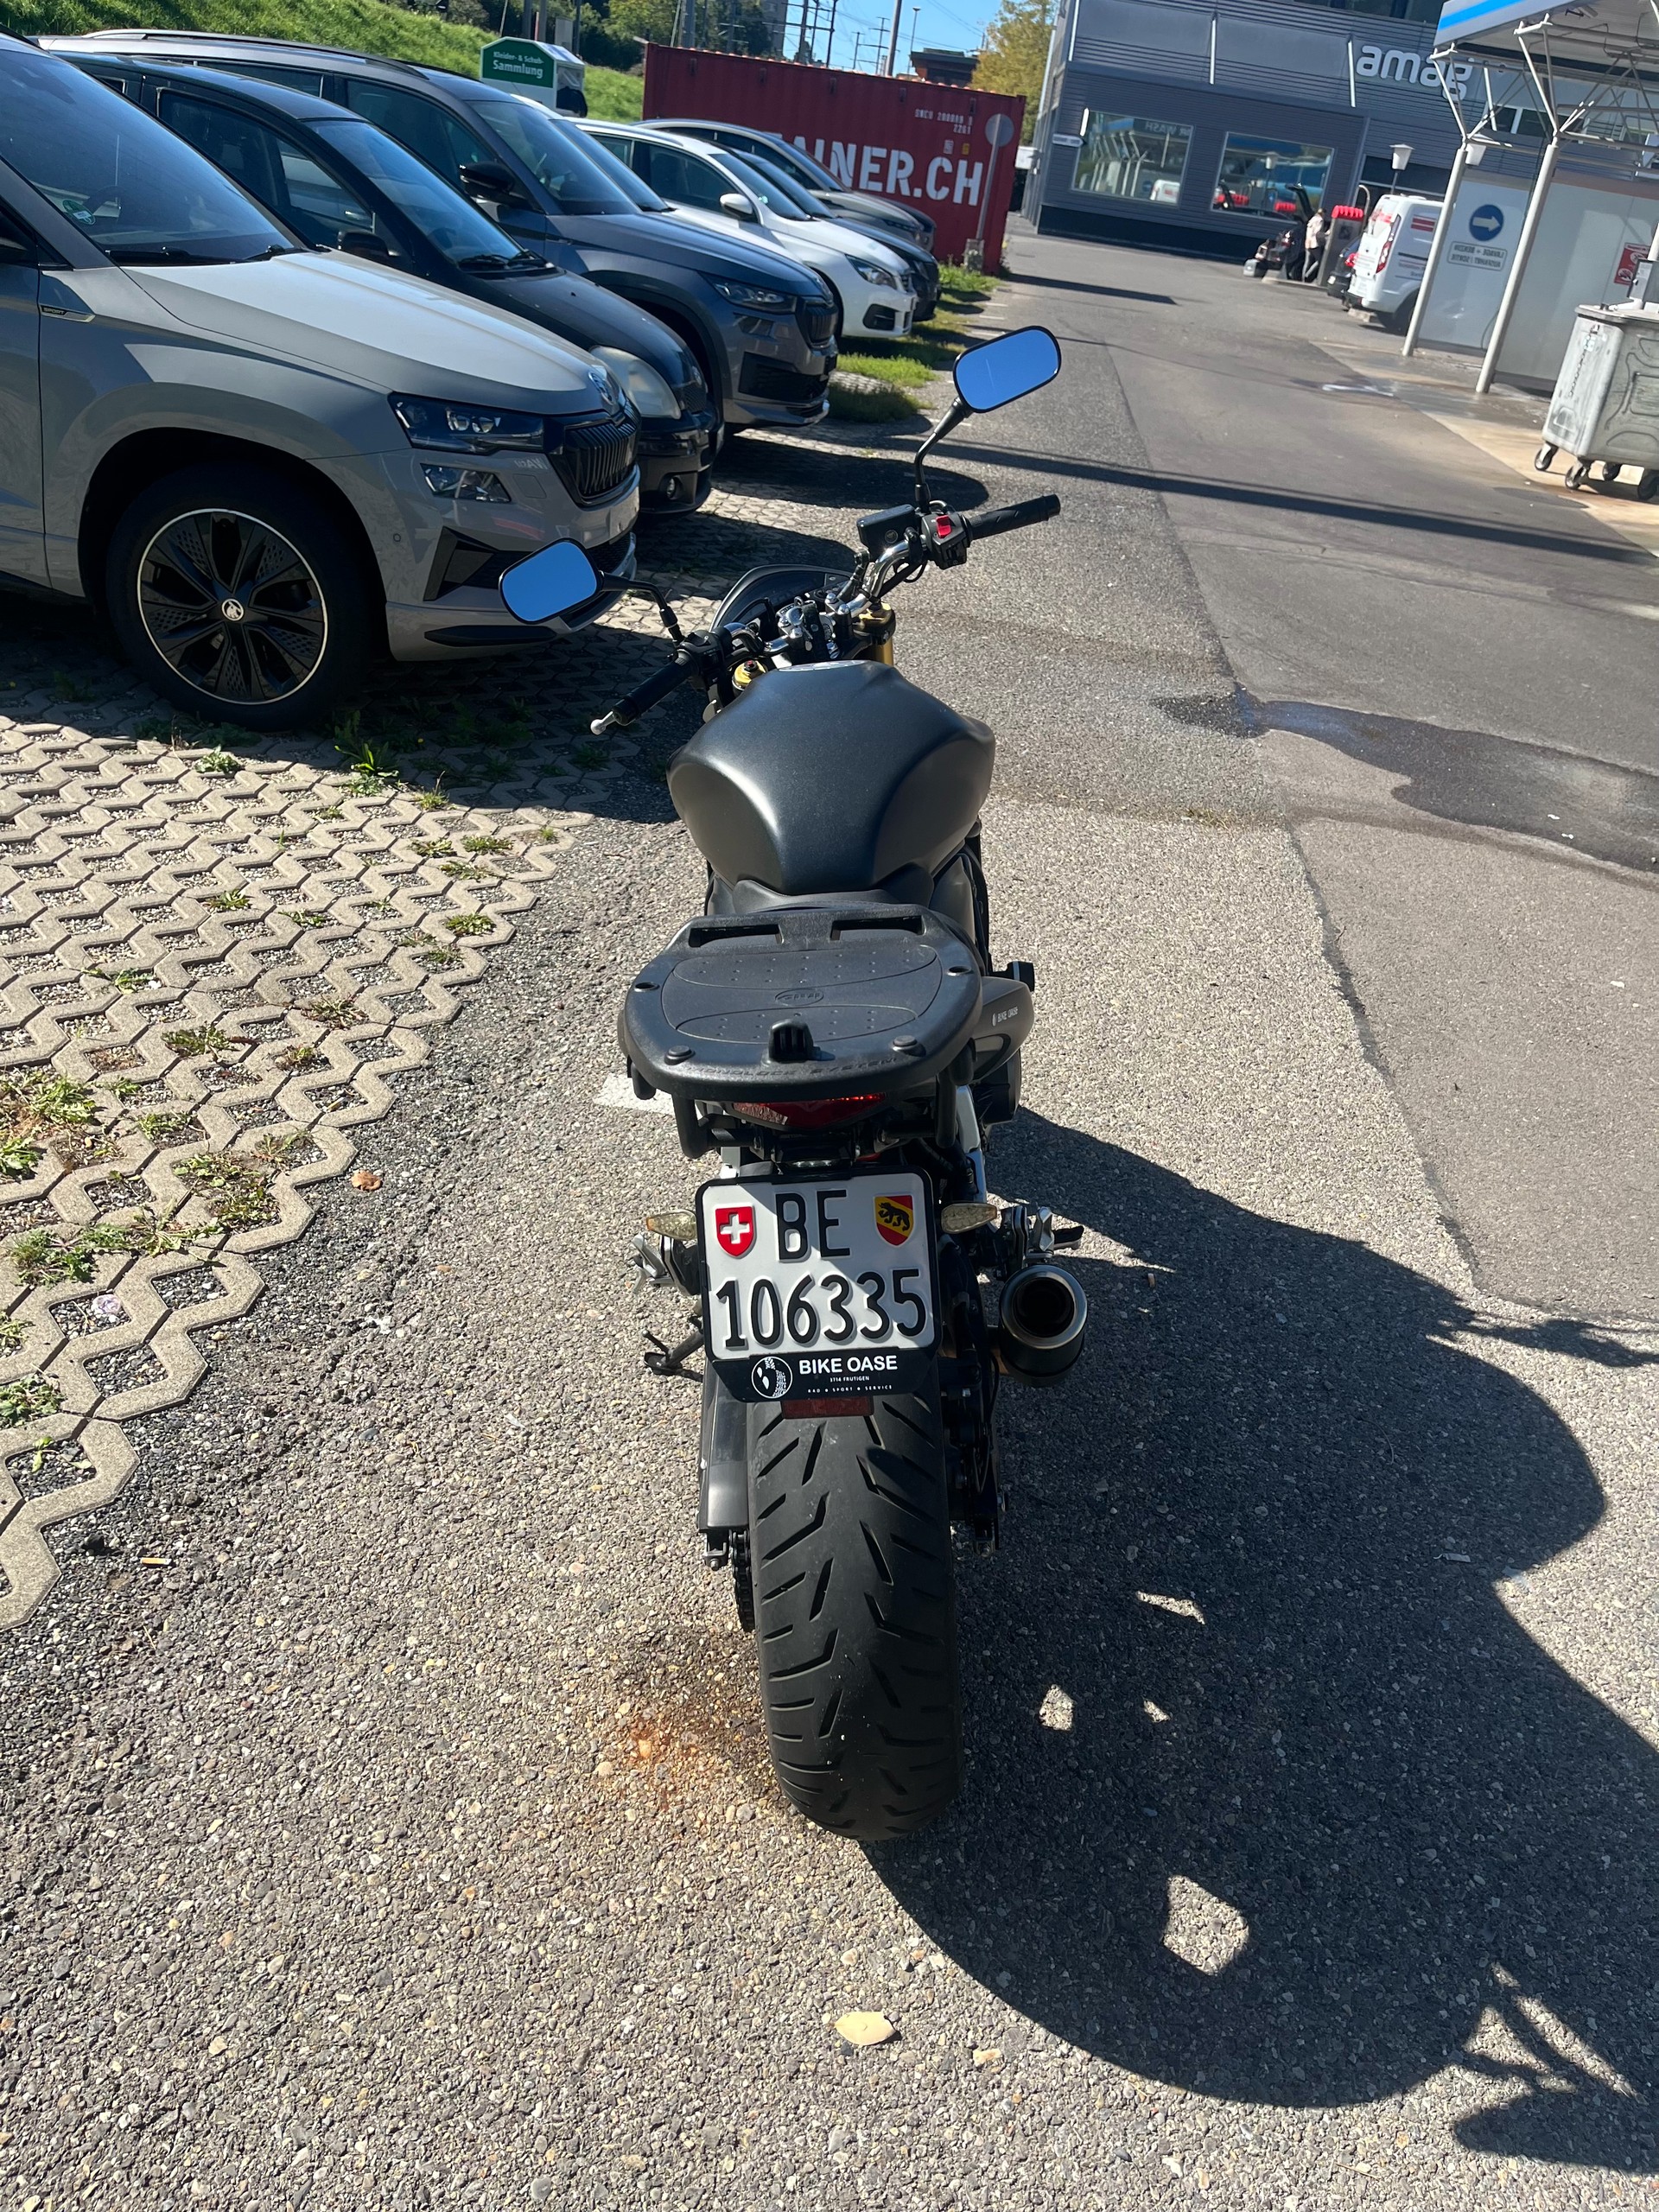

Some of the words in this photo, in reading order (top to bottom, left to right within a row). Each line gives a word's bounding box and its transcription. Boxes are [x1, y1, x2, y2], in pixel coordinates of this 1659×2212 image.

[493, 51, 517, 60] Kleider-
[524, 55, 544, 64] Schuh-
[493, 60, 543, 79] Sammlung
[1356, 45, 1473, 101] amag
[43, 307, 65, 315] SPORT
[775, 1189, 851, 1261] BE
[715, 1268, 926, 1348] 106335
[798, 1357, 842, 1375] BIKE
[847, 1355, 898, 1372] OASE
